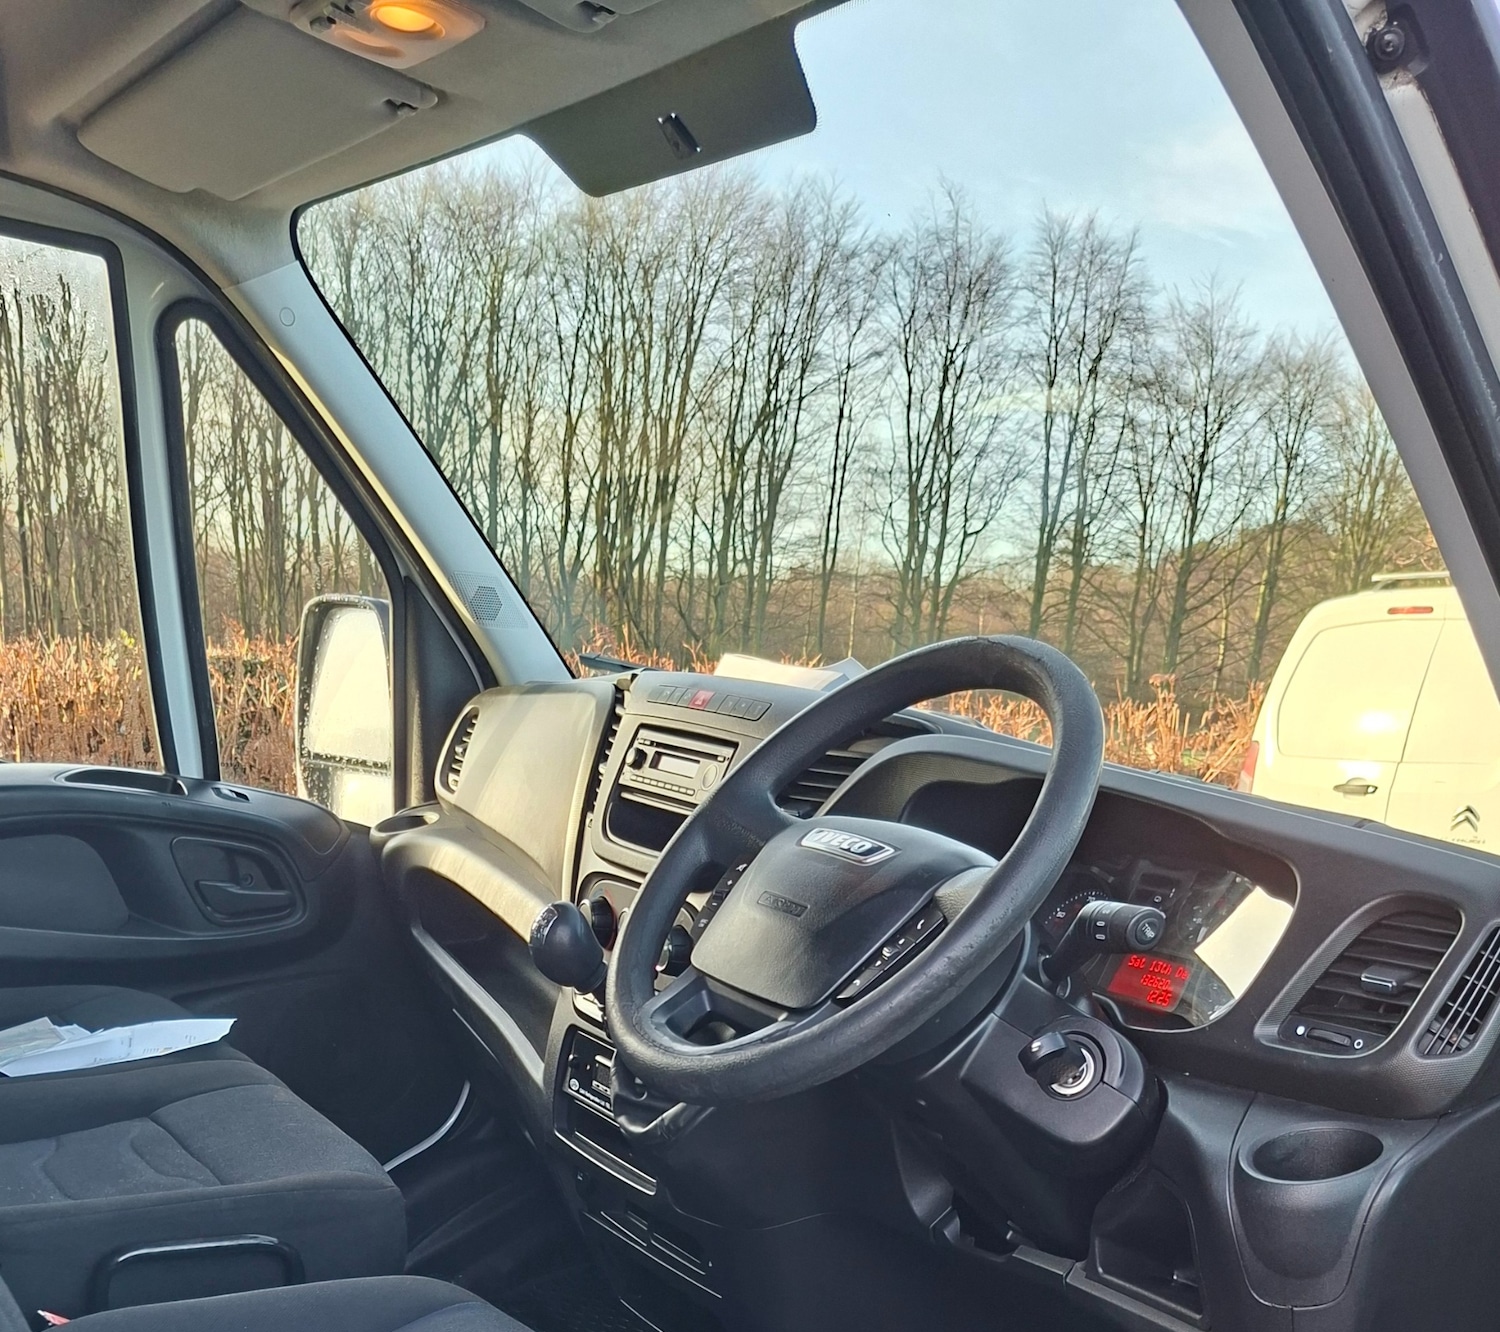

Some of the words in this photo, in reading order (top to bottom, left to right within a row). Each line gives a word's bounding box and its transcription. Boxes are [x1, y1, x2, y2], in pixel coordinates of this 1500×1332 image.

[815, 829, 874, 853] IVECO
[1141, 923, 1156, 939] TRIP
[1128, 954, 1146, 969] Sat
[1149, 960, 1172, 975] 13th
